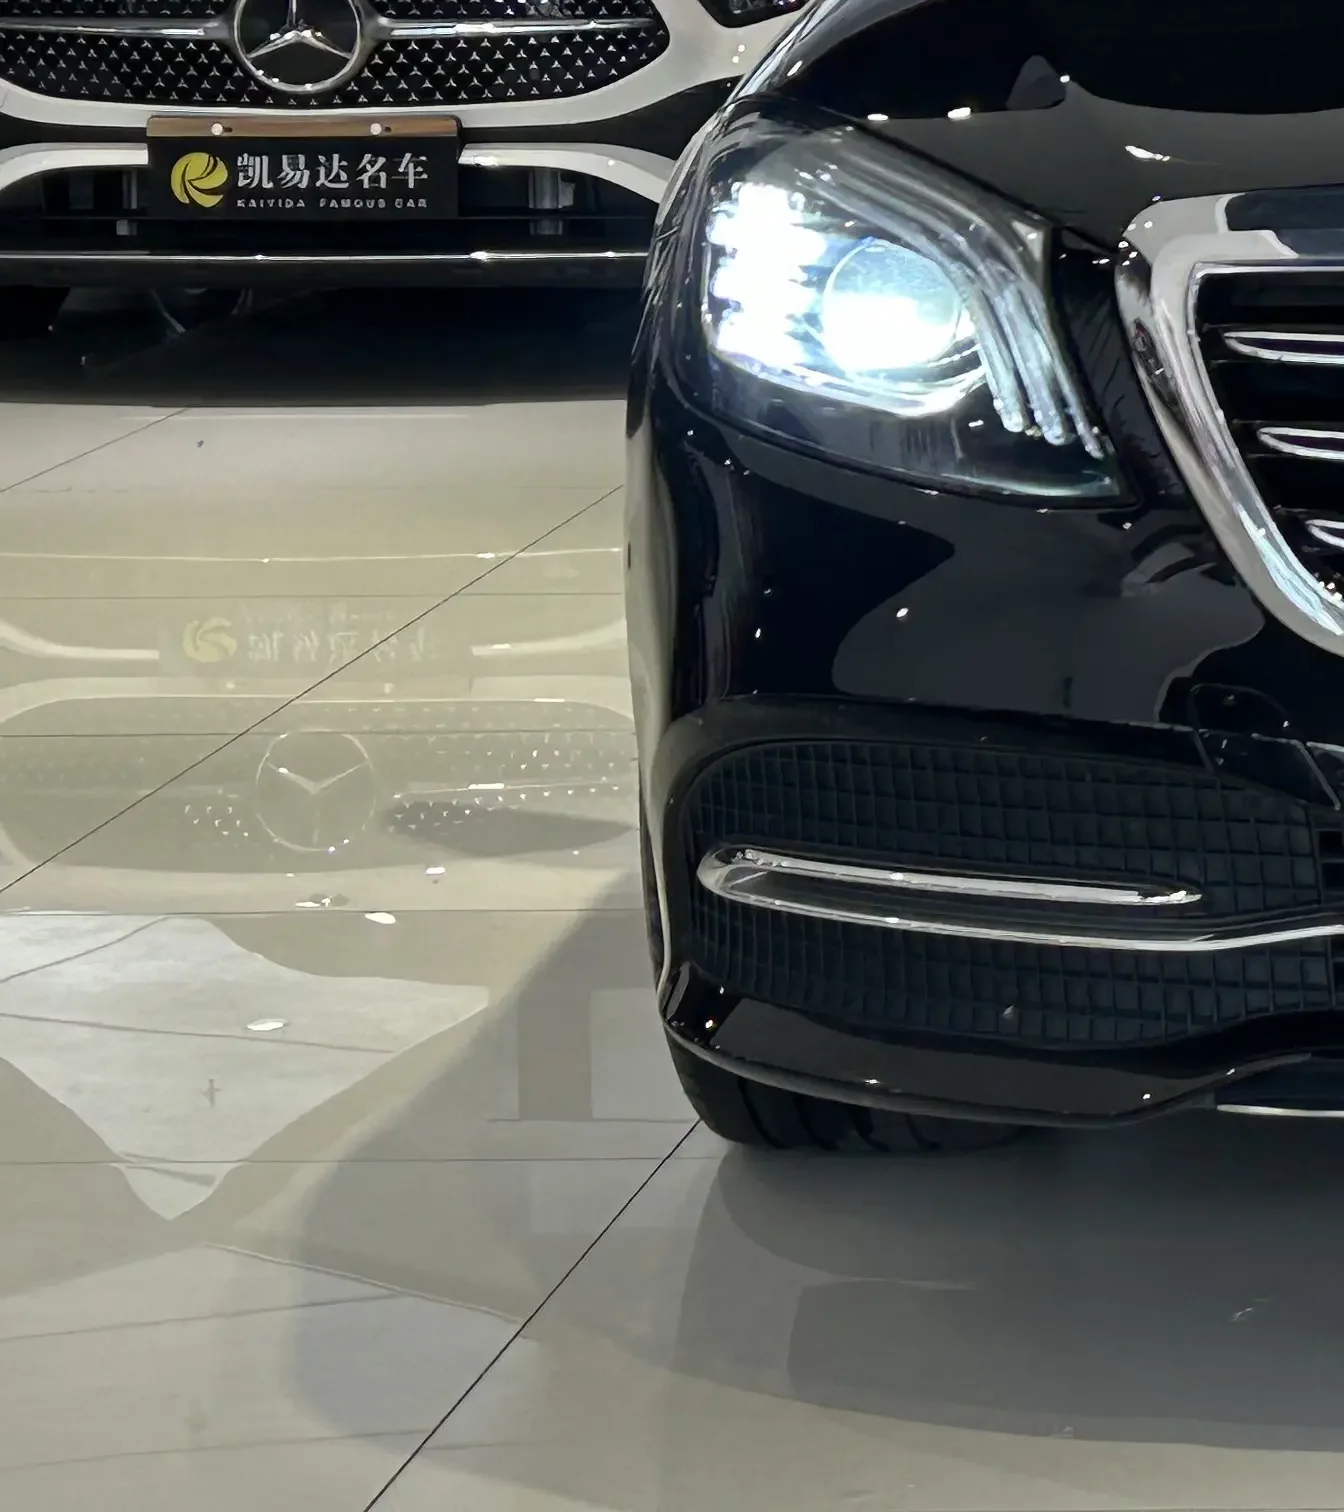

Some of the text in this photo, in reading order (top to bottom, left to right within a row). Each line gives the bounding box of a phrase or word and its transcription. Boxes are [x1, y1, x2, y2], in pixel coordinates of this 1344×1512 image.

[236, 152, 429, 189] 凯易达名车
[236, 197, 428, 209] KAIYIDA FAMOUS CAR
